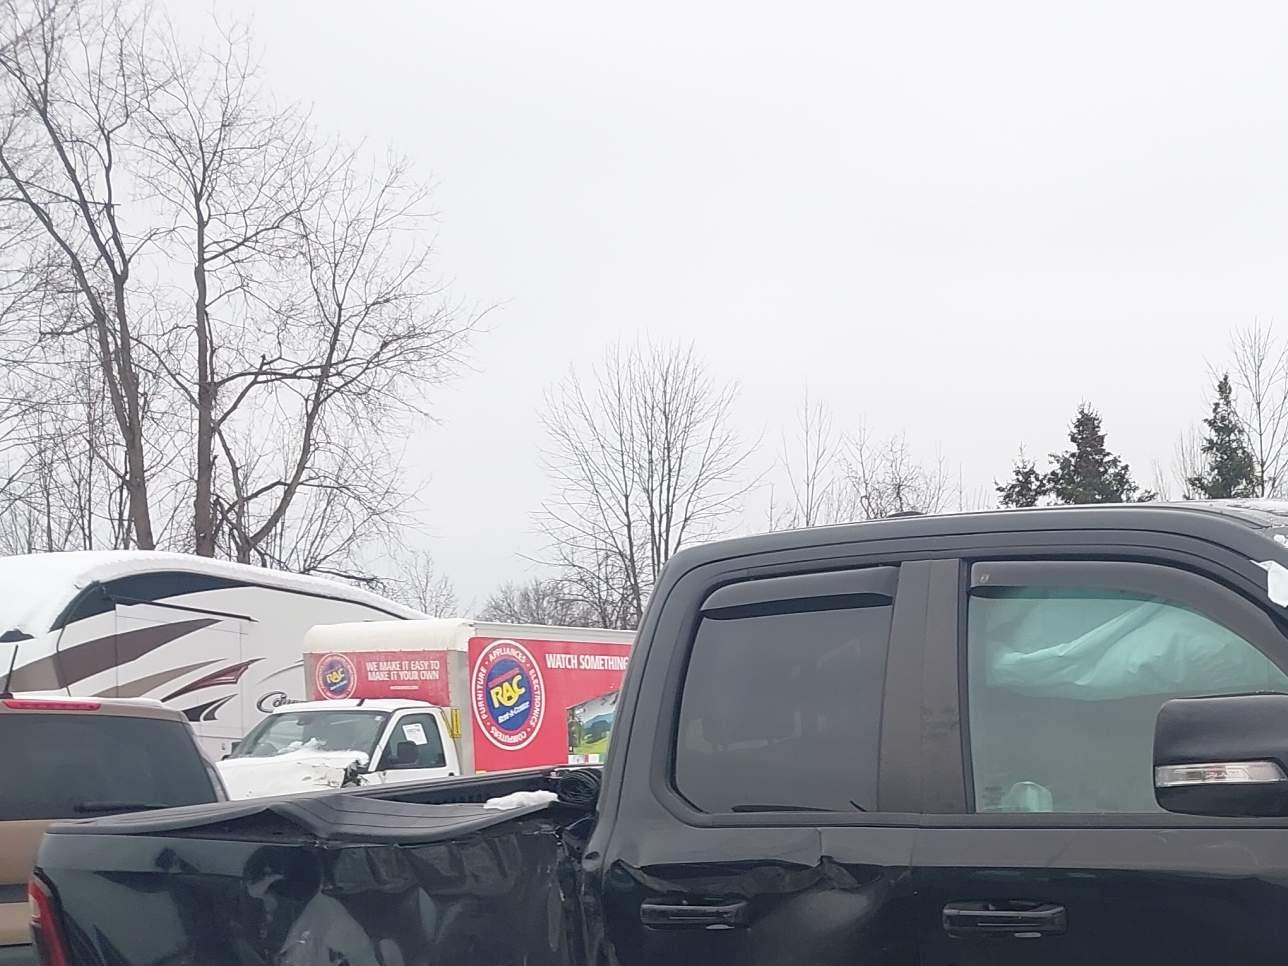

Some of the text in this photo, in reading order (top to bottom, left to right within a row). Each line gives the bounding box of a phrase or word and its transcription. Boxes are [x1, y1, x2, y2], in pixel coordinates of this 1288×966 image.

[366, 660, 440, 671] WE MAKE IT EASY TO
[545, 653, 578, 669] WATCH
[326, 667, 345, 684] RAC
[368, 670, 440, 681] MAKE IT YOUR OWN
[489, 674, 526, 709] RAC
[528, 668, 541, 728] ELECTRONICS
